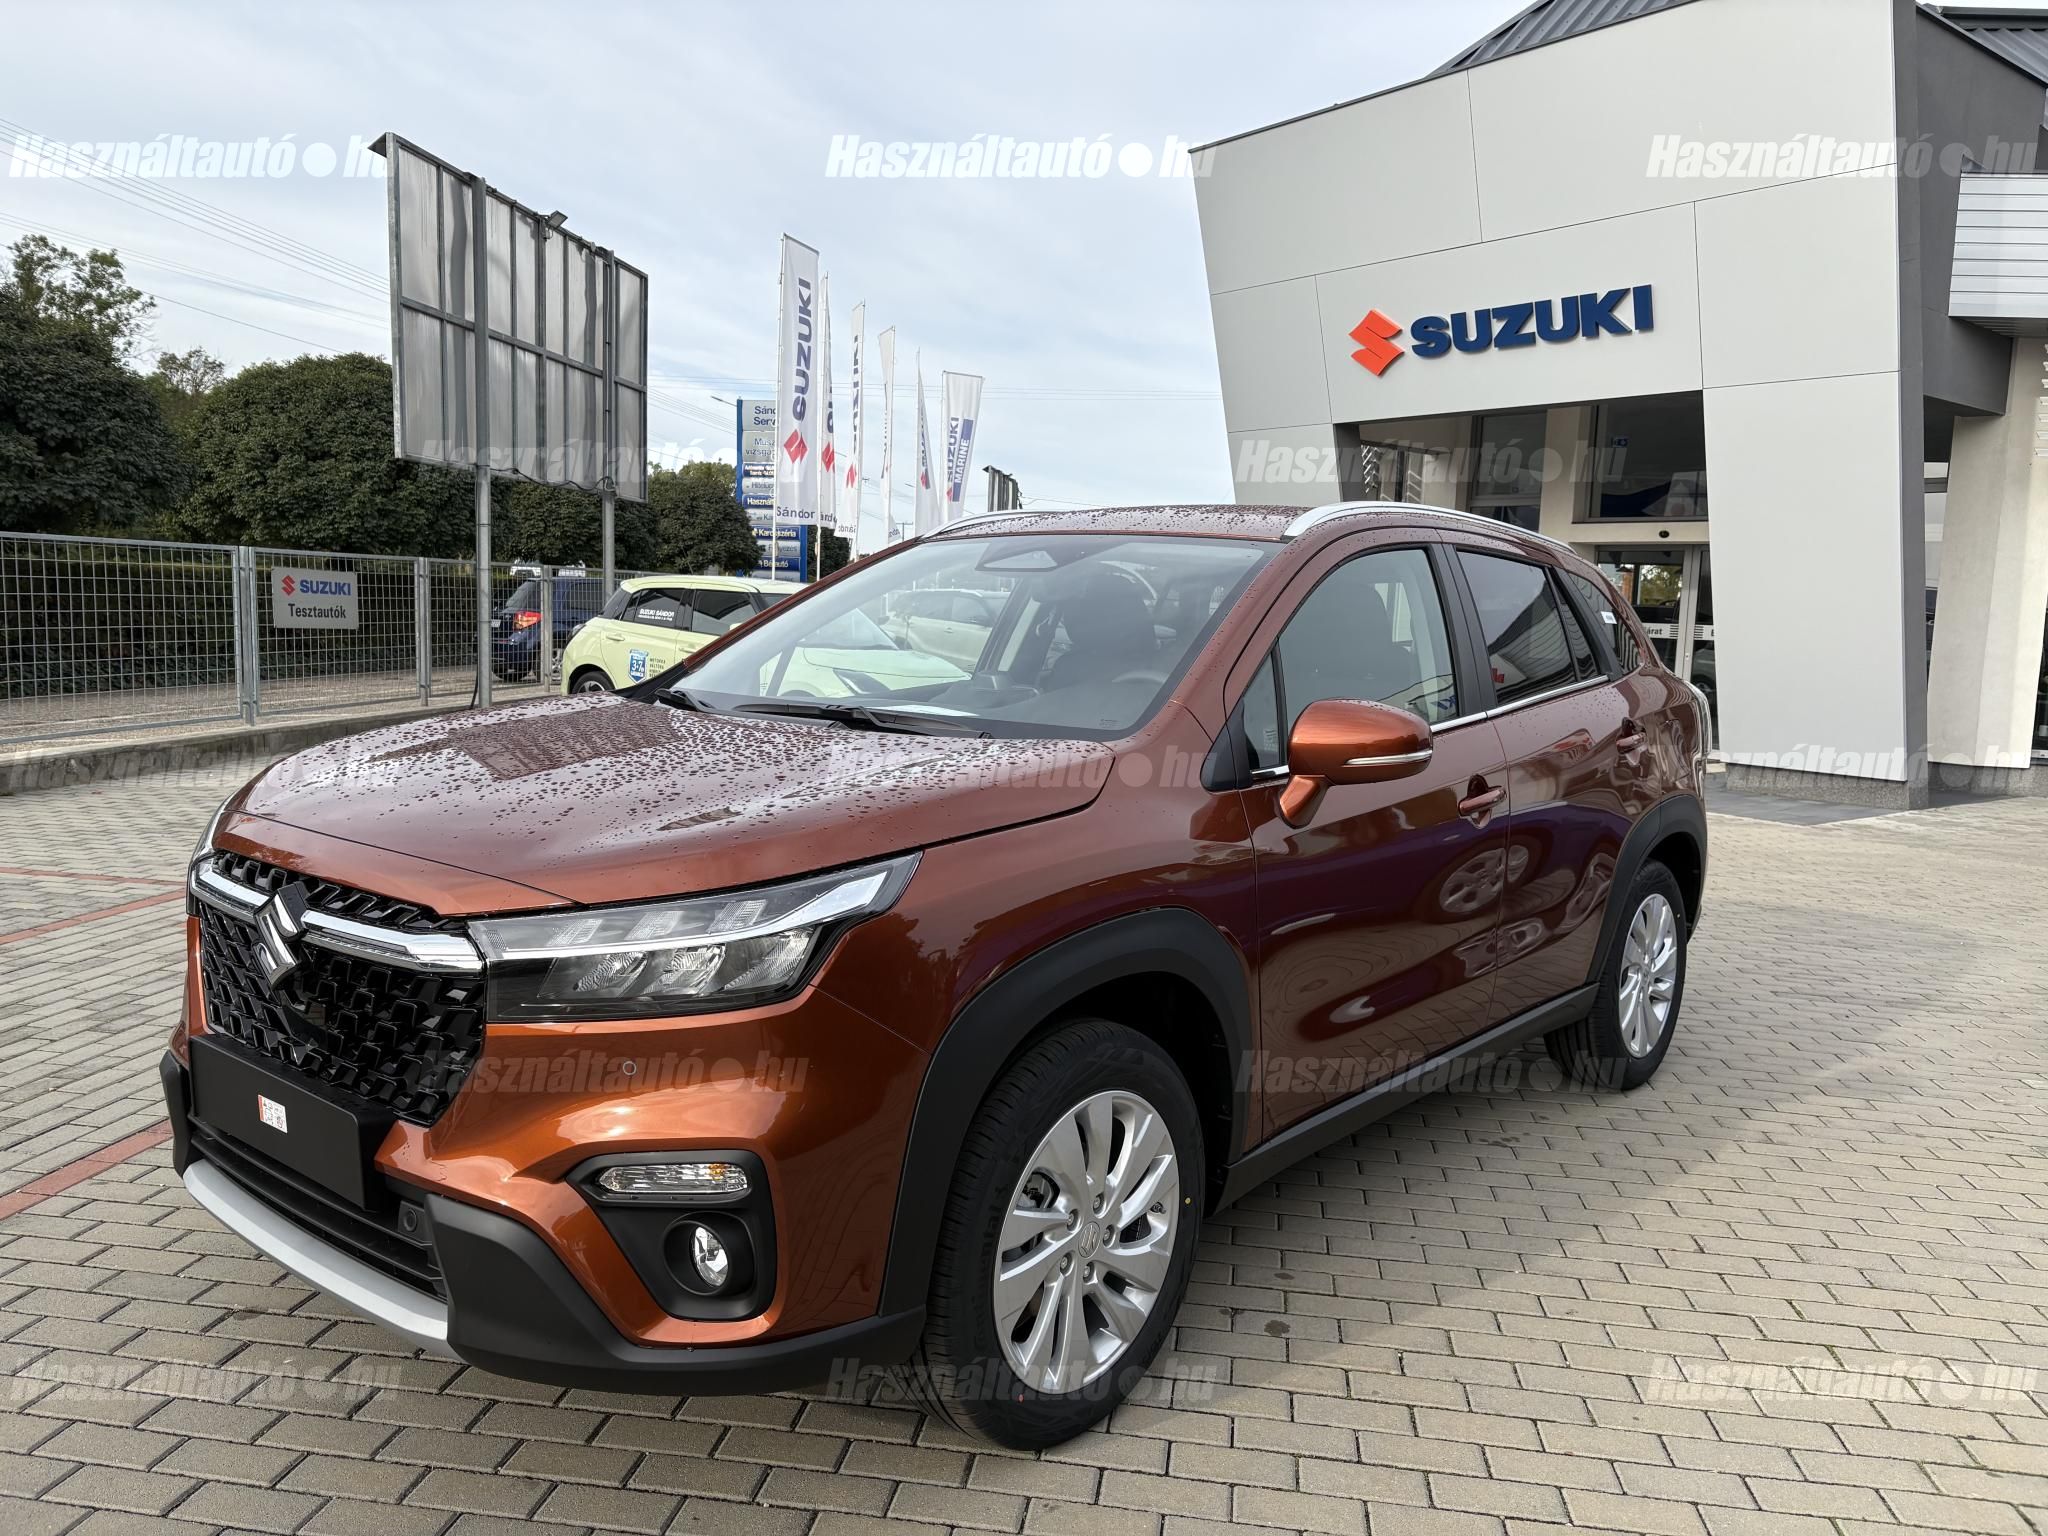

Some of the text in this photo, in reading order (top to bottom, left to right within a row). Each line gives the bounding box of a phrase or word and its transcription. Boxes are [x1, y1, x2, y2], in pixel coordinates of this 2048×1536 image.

[1410, 284, 1654, 359] SUZUKI
[792, 277, 812, 422] SUZUKI
[953, 440, 970, 482] MARINE
[777, 506, 816, 519] Sándor
[299, 579, 352, 596] SUZUKI
[287, 603, 347, 619] Tesztautók
